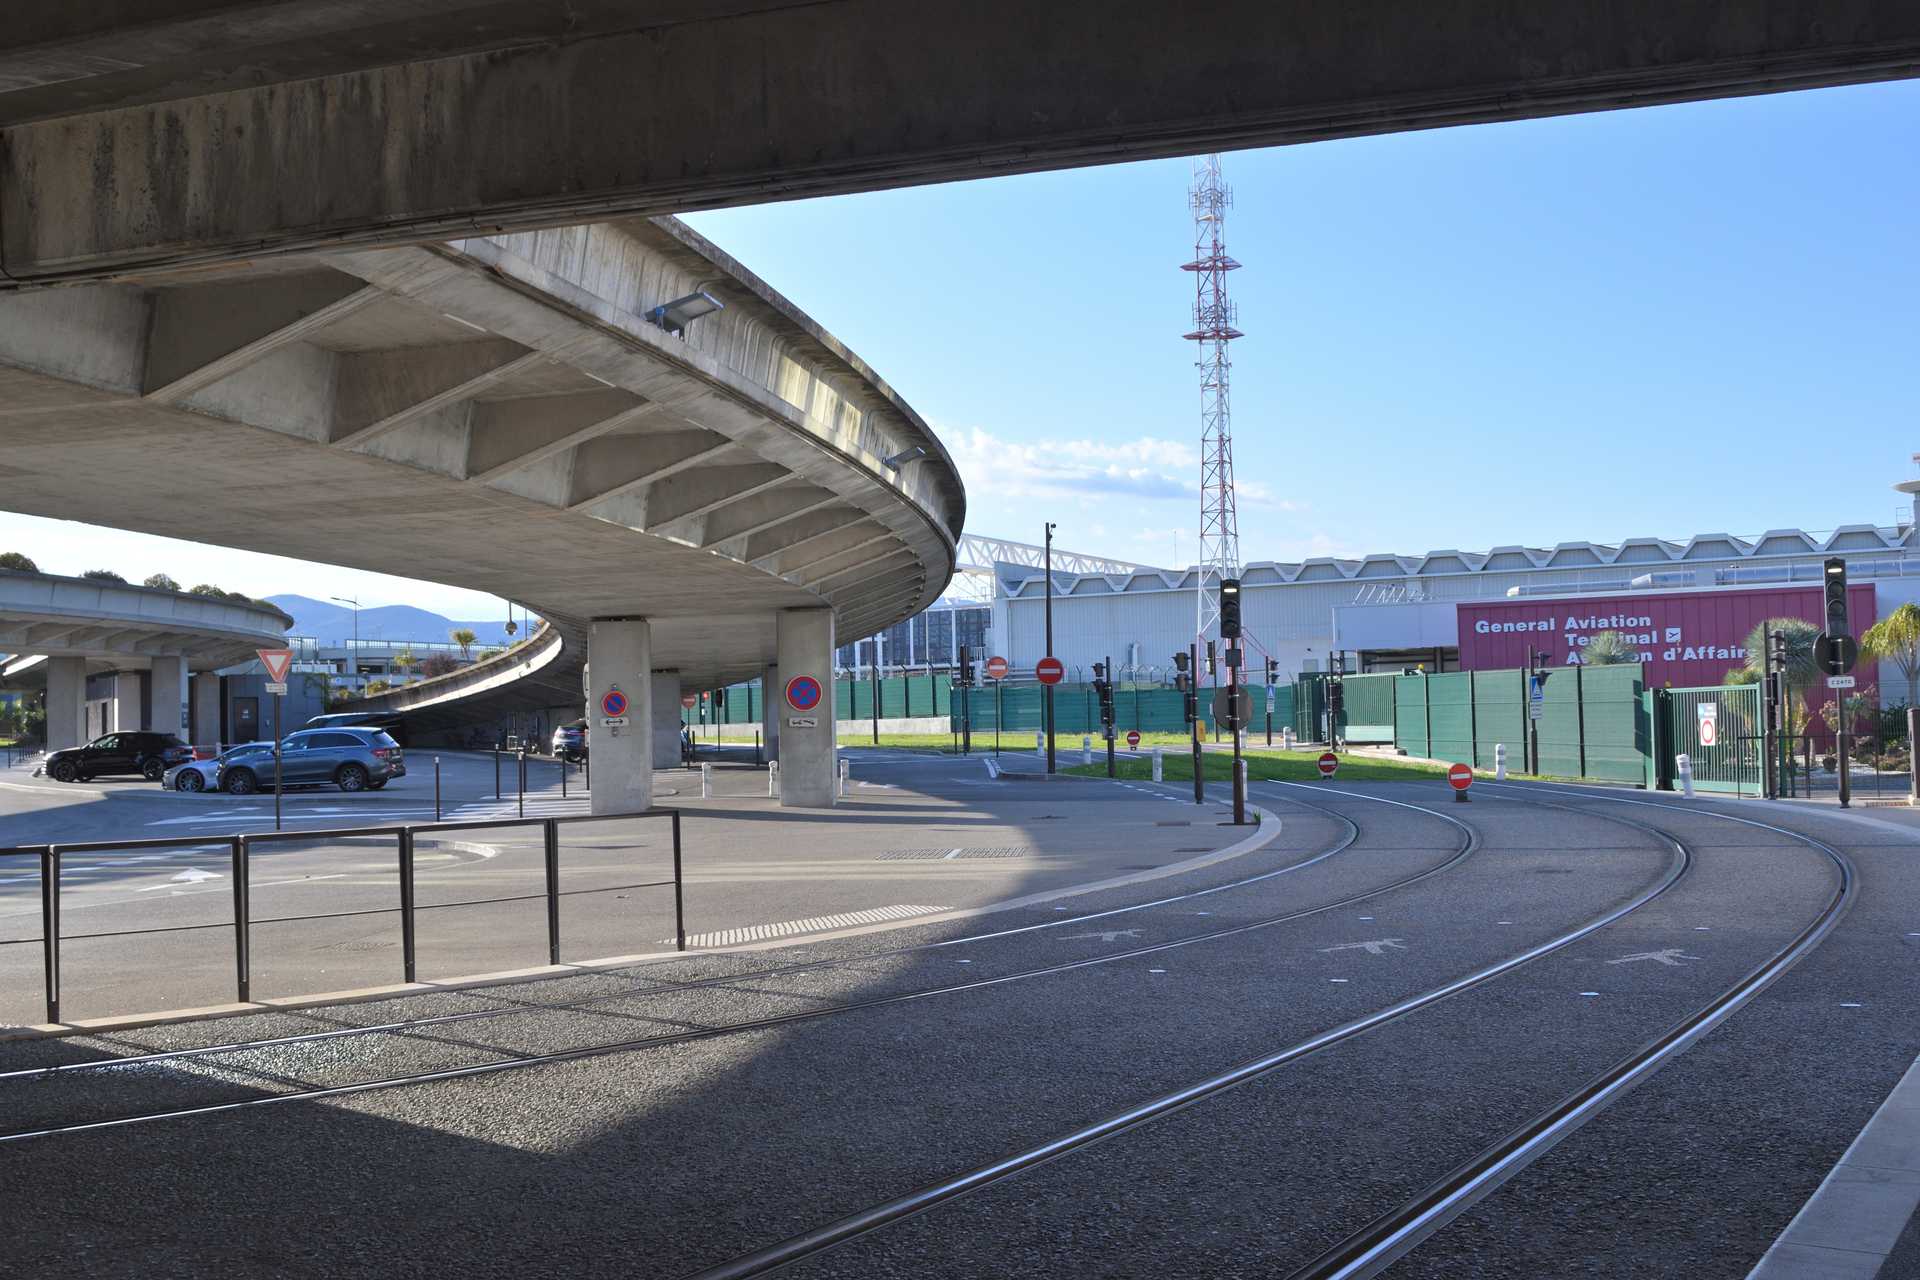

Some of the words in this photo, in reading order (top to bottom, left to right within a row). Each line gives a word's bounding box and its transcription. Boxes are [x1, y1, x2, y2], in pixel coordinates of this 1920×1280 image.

[1475, 617, 1556, 634] General
[1565, 615, 1652, 631] Aviation
[1564, 630, 1658, 646] Terinal
[1663, 645, 1750, 661] d'Affair
